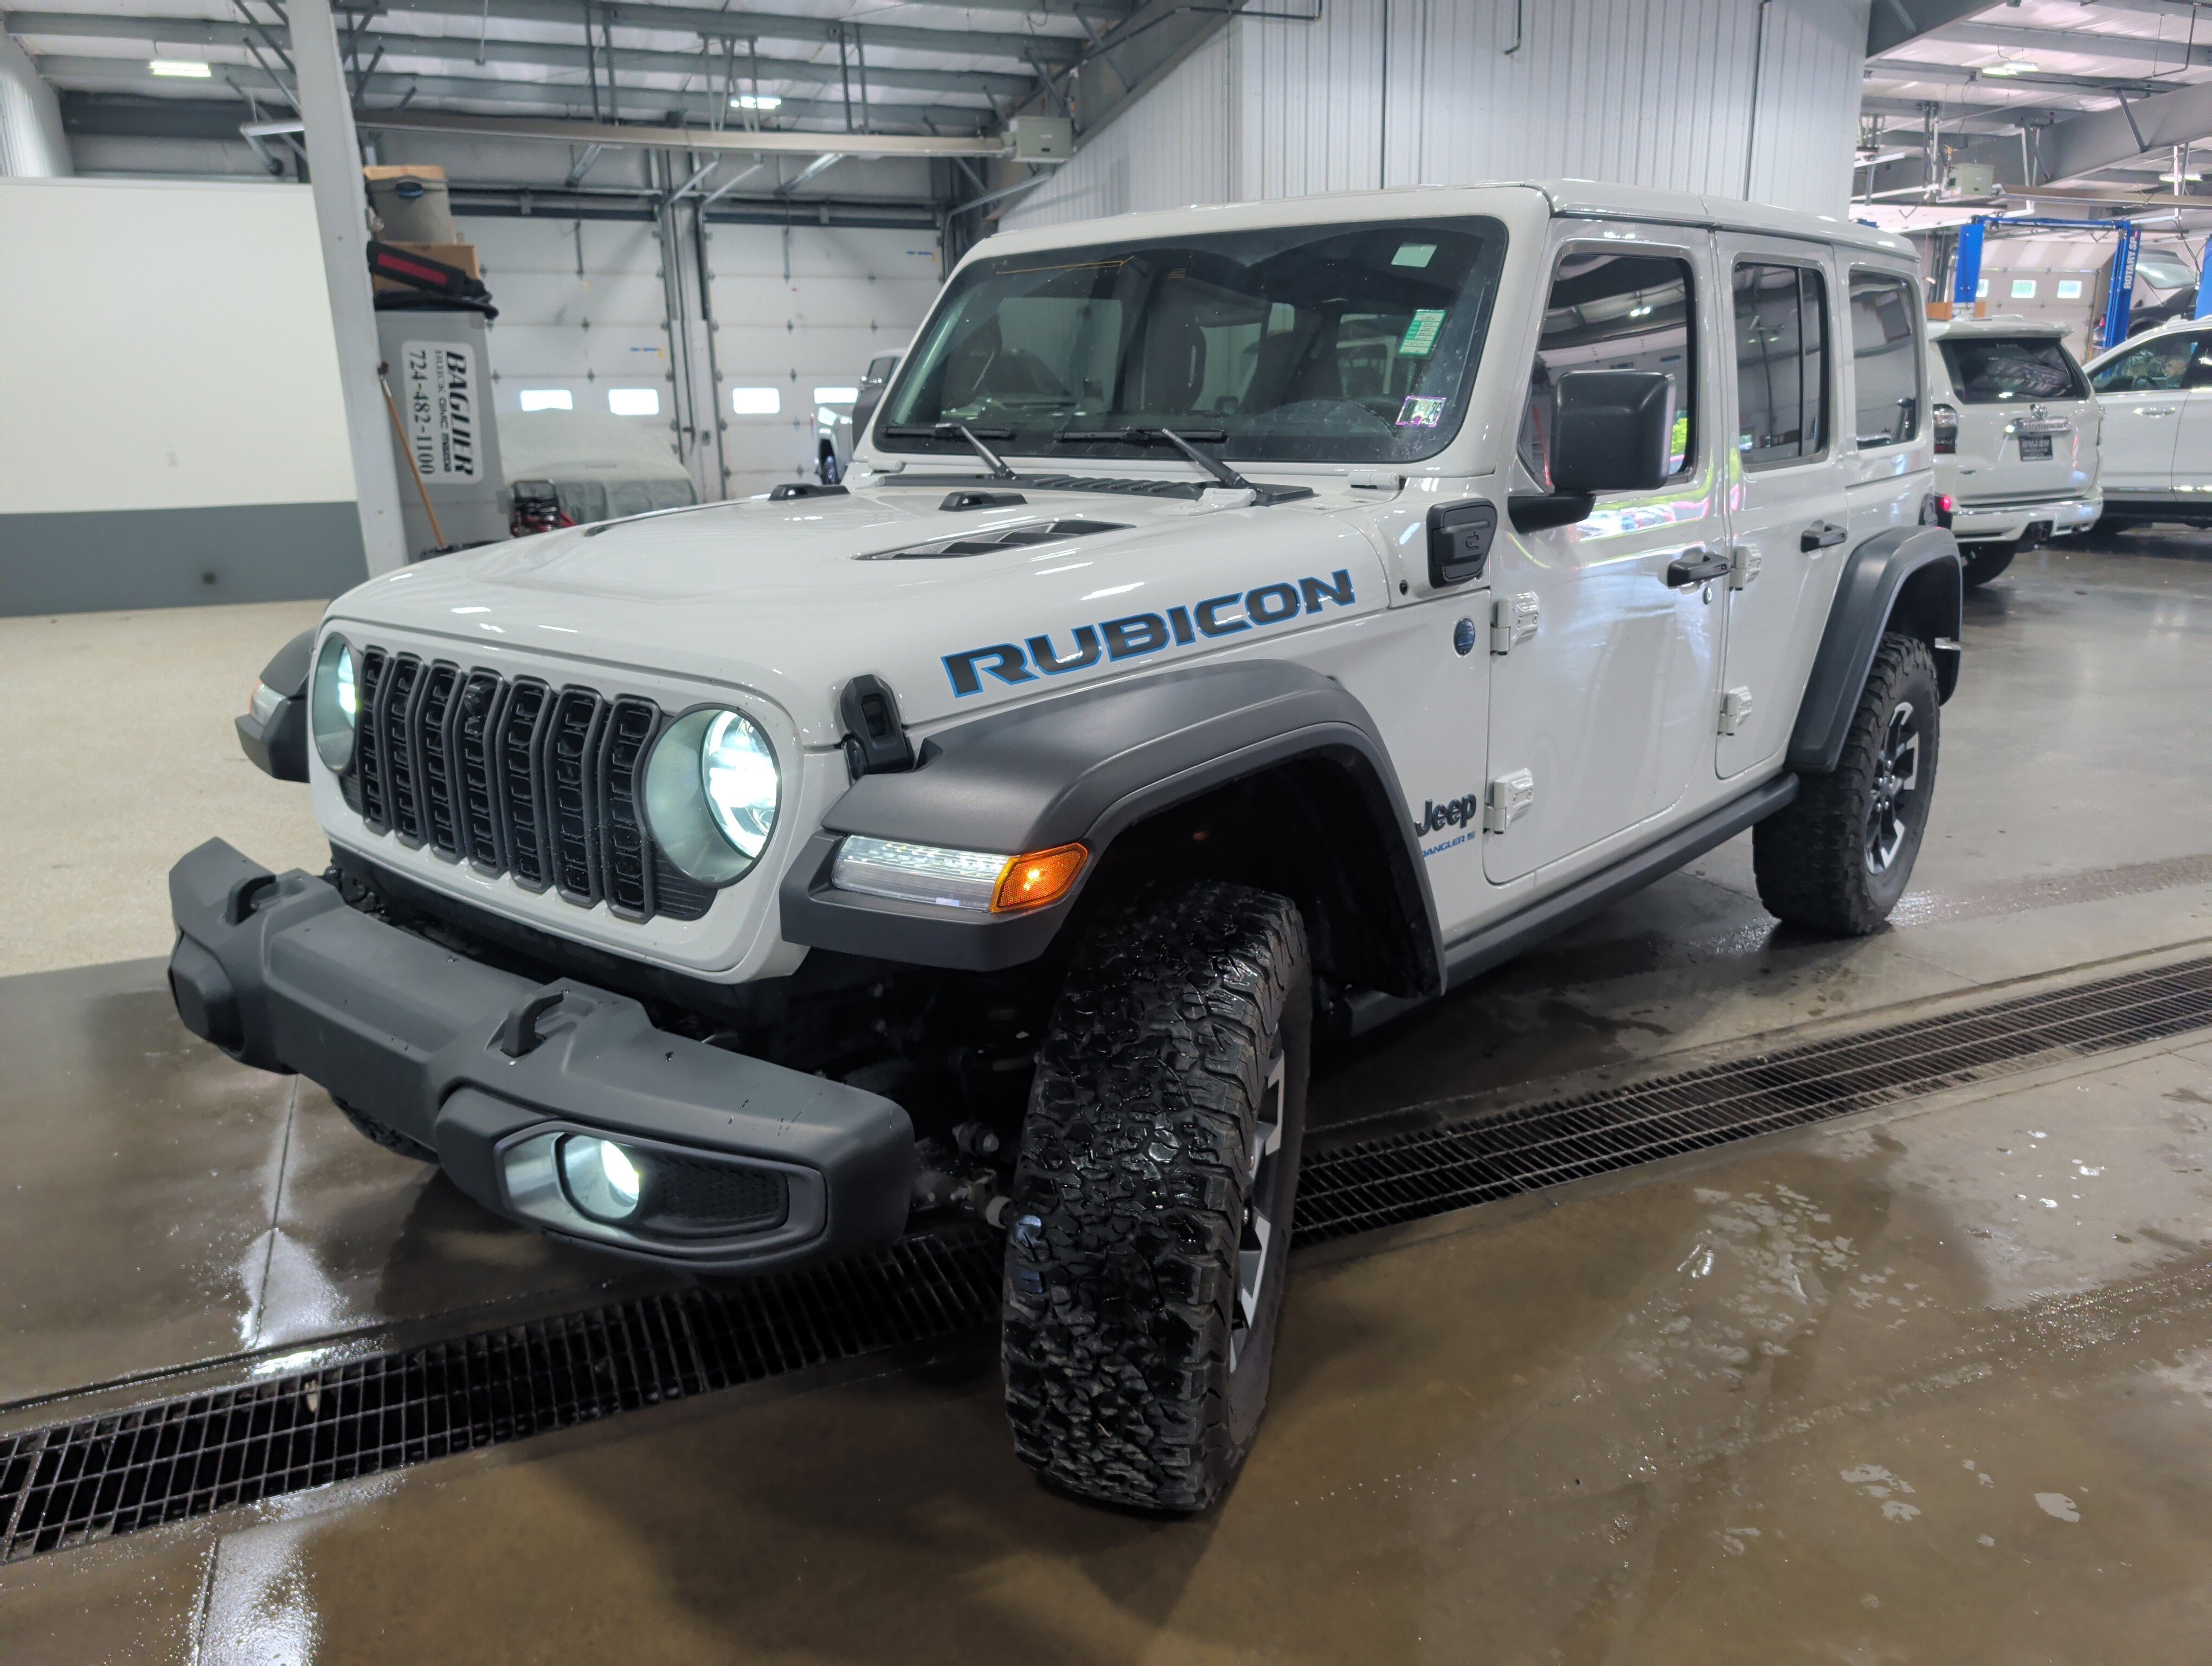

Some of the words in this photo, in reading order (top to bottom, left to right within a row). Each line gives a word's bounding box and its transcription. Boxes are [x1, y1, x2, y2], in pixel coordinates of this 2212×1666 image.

[409, 350, 435, 474] 724-482-1100
[439, 397, 449, 428] GMC
[446, 351, 474, 476] BAGLIER
[941, 568, 1356, 699] RUBICON
[1414, 793, 1476, 837] Jeep
